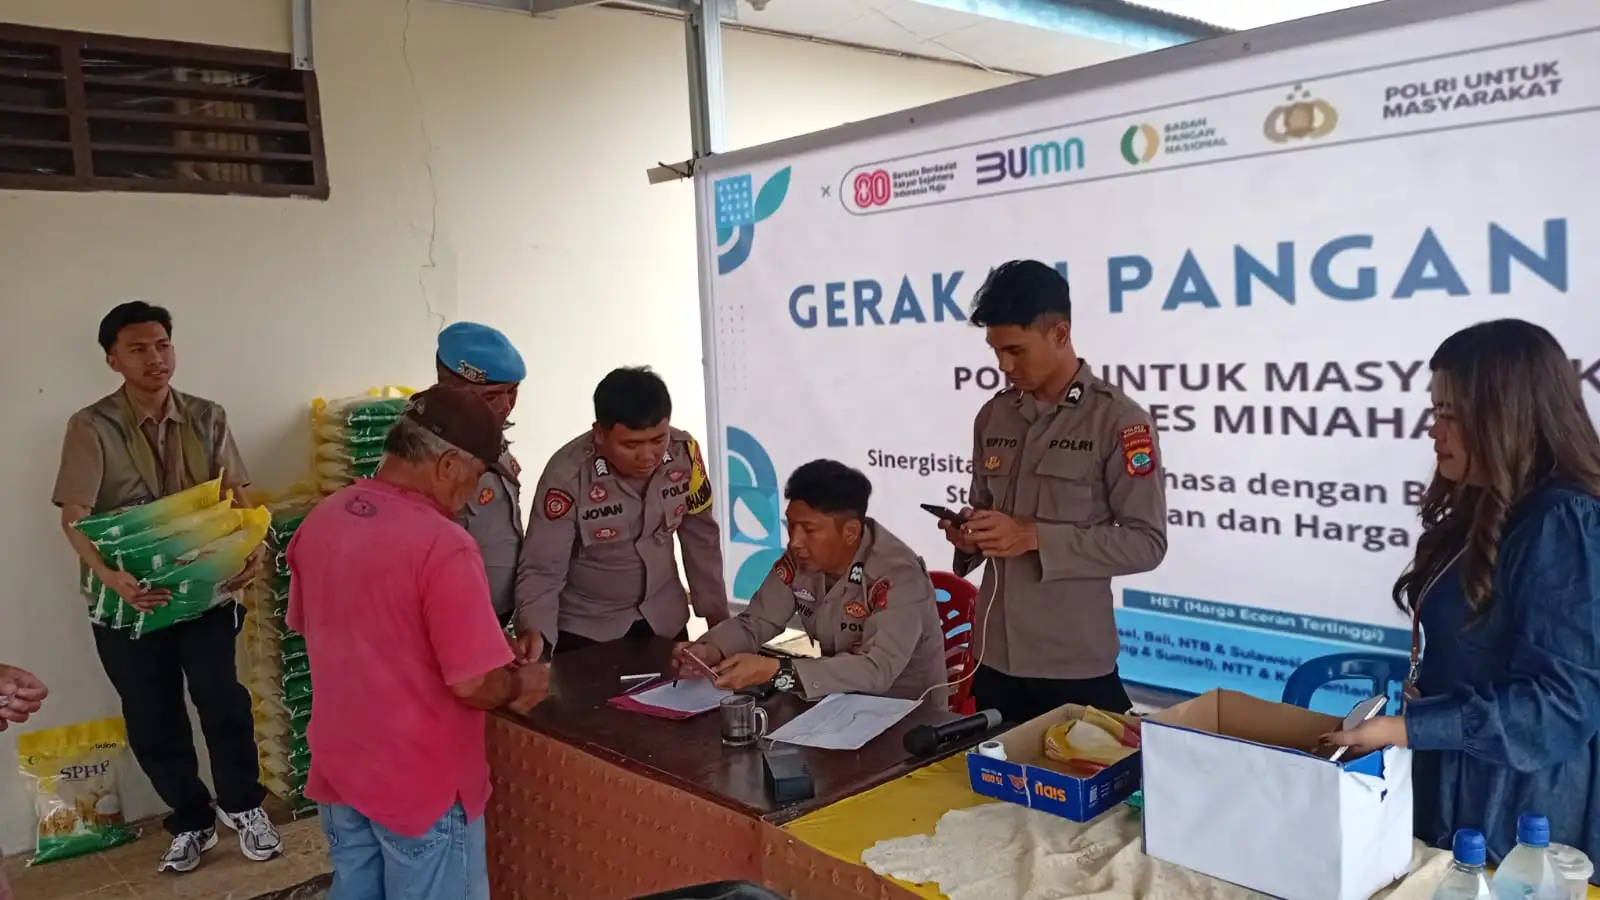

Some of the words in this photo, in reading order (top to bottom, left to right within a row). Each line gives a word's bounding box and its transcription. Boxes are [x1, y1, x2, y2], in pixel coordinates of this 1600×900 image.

[1385, 77, 1457, 101] POLRI
[1464, 61, 1560, 90] UNTUK
[1383, 79, 1562, 119] MASYARAKAT
[854, 169, 890, 208] 80
[1107, 217, 1568, 314] PANGAN
[1050, 439, 1094, 452] POLRI
[868, 448, 974, 477] Sinergisita
[1247, 472, 1388, 507] dengan
[582, 503, 623, 520] JOVAN
[1217, 508, 1281, 536] dan
[1295, 513, 1410, 552] Harga
[840, 622, 864, 632] POL
[1150, 595, 1179, 609] HET
[1240, 608, 1296, 627] Eceran
[1178, 637, 1211, 653] NTB
[1222, 659, 1254, 677] NTT
